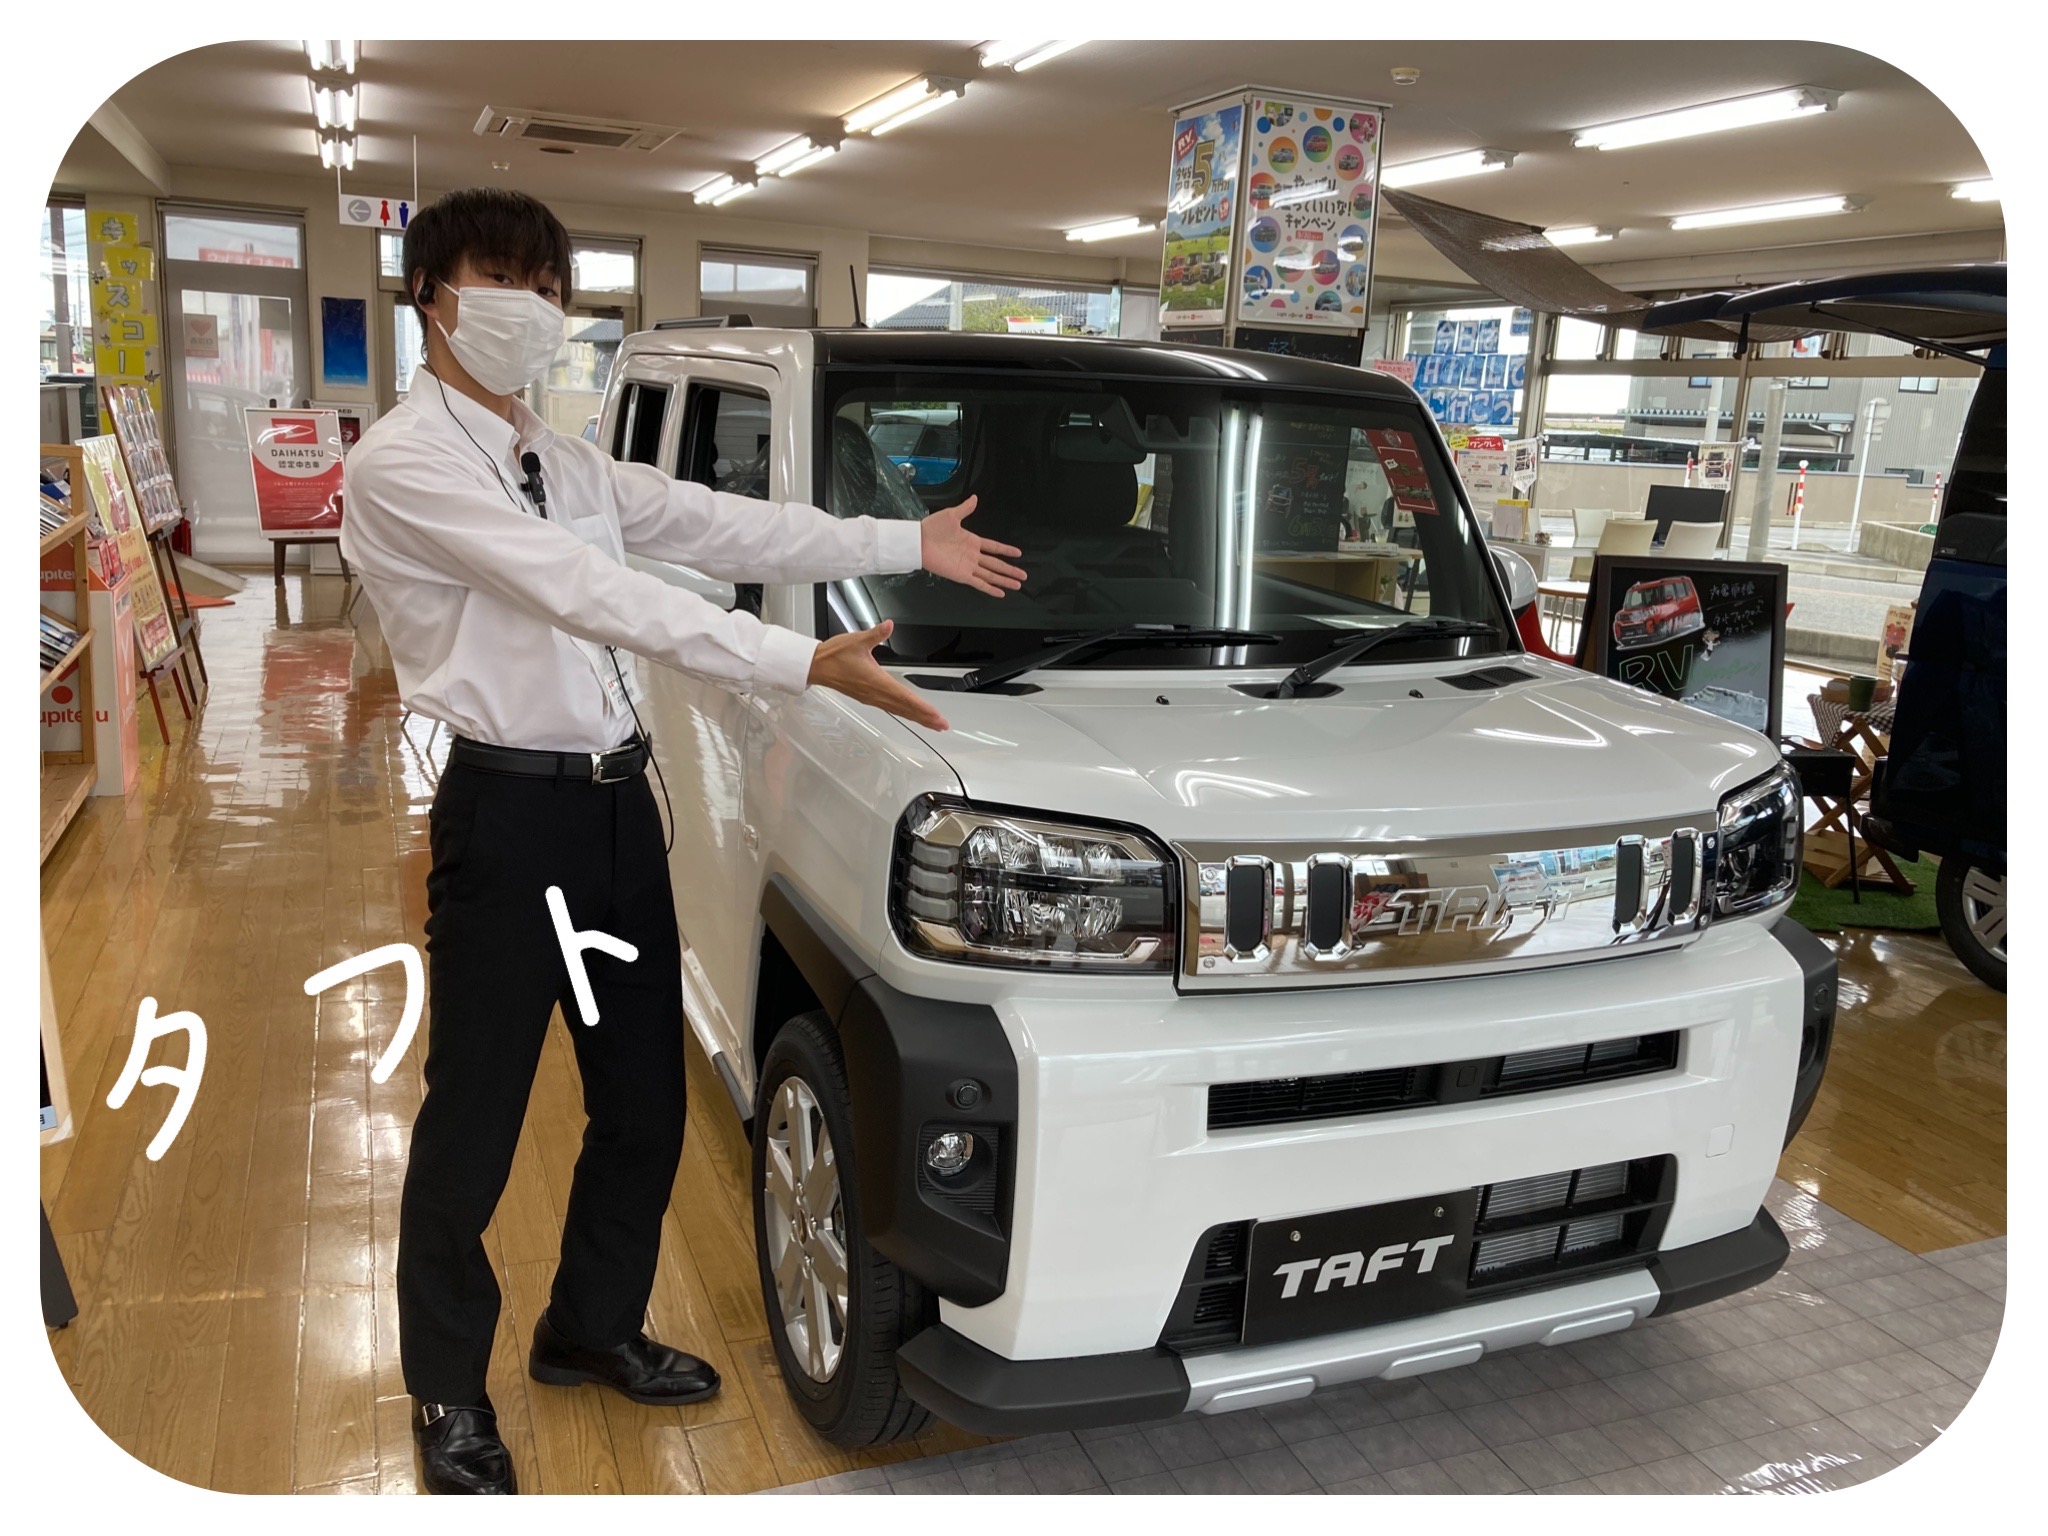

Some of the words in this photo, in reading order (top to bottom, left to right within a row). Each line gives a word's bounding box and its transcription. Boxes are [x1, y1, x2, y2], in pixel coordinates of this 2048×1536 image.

[1191, 139, 1215, 199] 5
[1285, 213, 1336, 231] キャンペーン
[102, 217, 145, 386] キッズコー
[271, 449, 324, 457] DAIHATSU
[1619, 644, 1694, 694] RV
[1386, 876, 1588, 936] TAFT
[1273, 1235, 1454, 1299] TAFT
